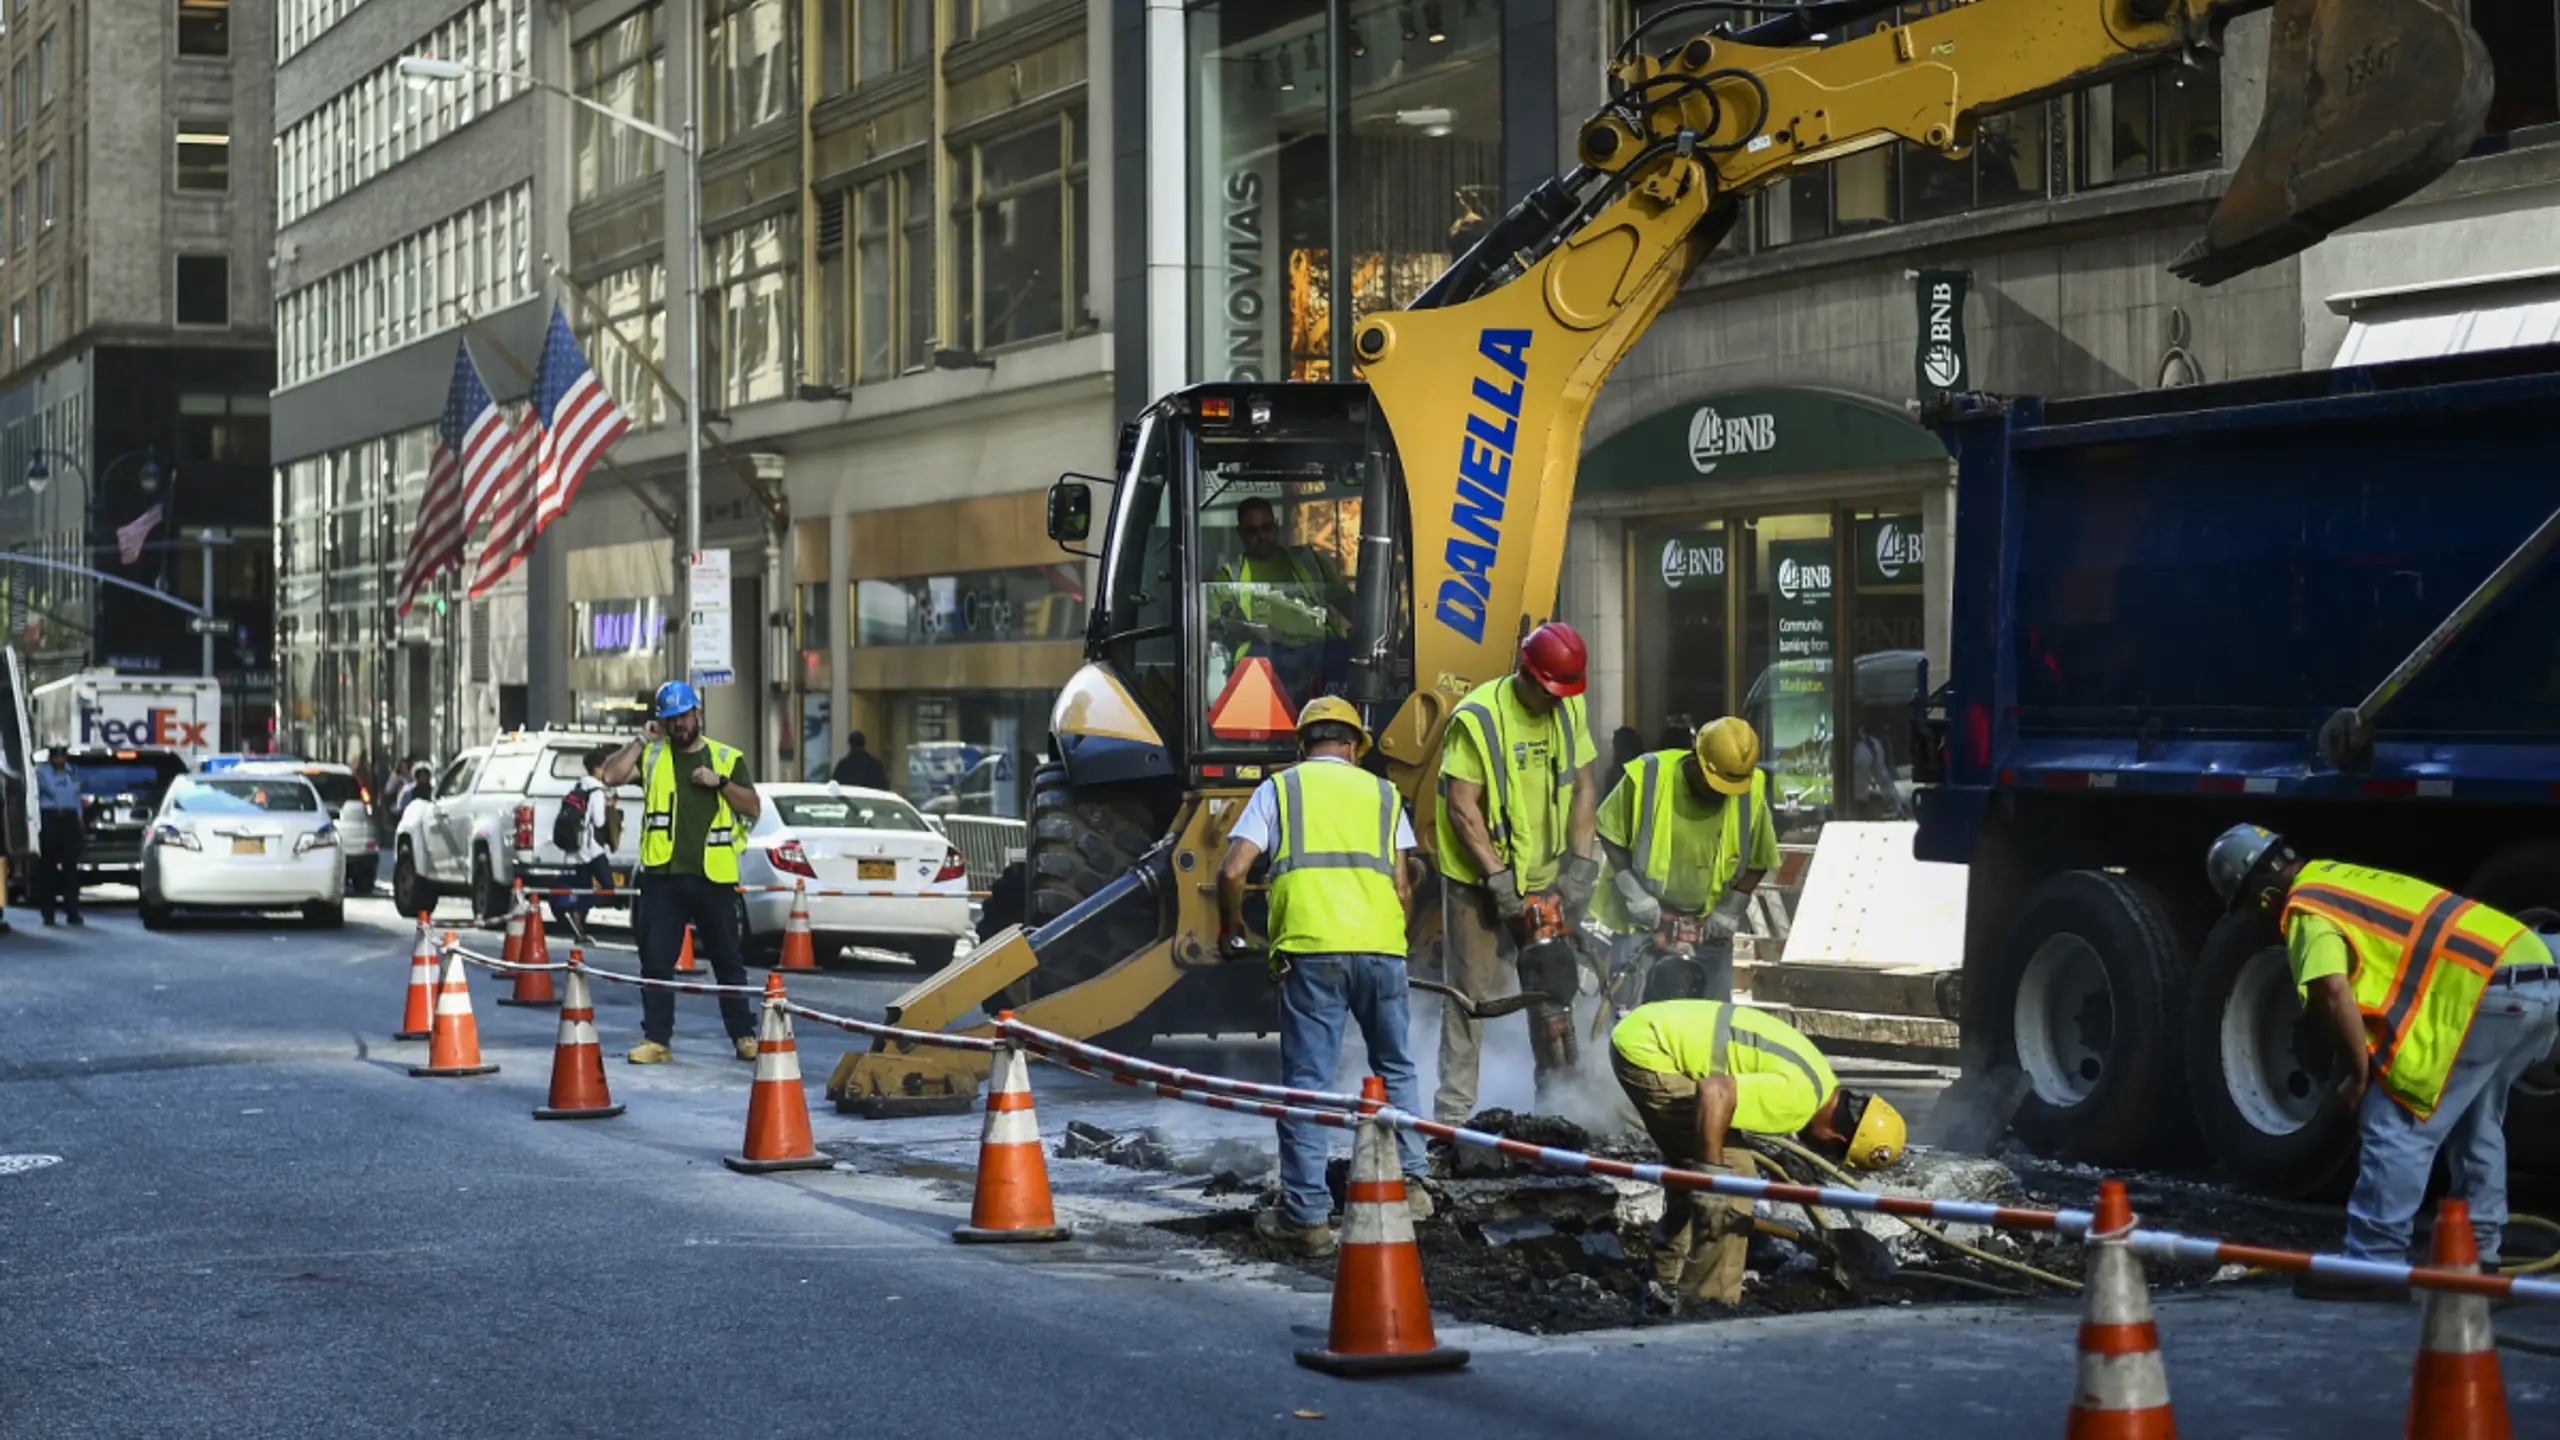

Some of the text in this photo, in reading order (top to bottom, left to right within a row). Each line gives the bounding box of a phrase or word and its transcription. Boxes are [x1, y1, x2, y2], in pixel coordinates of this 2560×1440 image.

[1931, 282, 1951, 341] BNB
[1724, 413, 1776, 455] BNB
[1435, 328, 1533, 645] DANELLA
[1689, 547, 1724, 576] BNB
[1801, 564, 1831, 589] BNB
[1779, 618, 1823, 633] Community
[1779, 637, 1829, 655] banking from
[80, 707, 208, 748] FedEx
